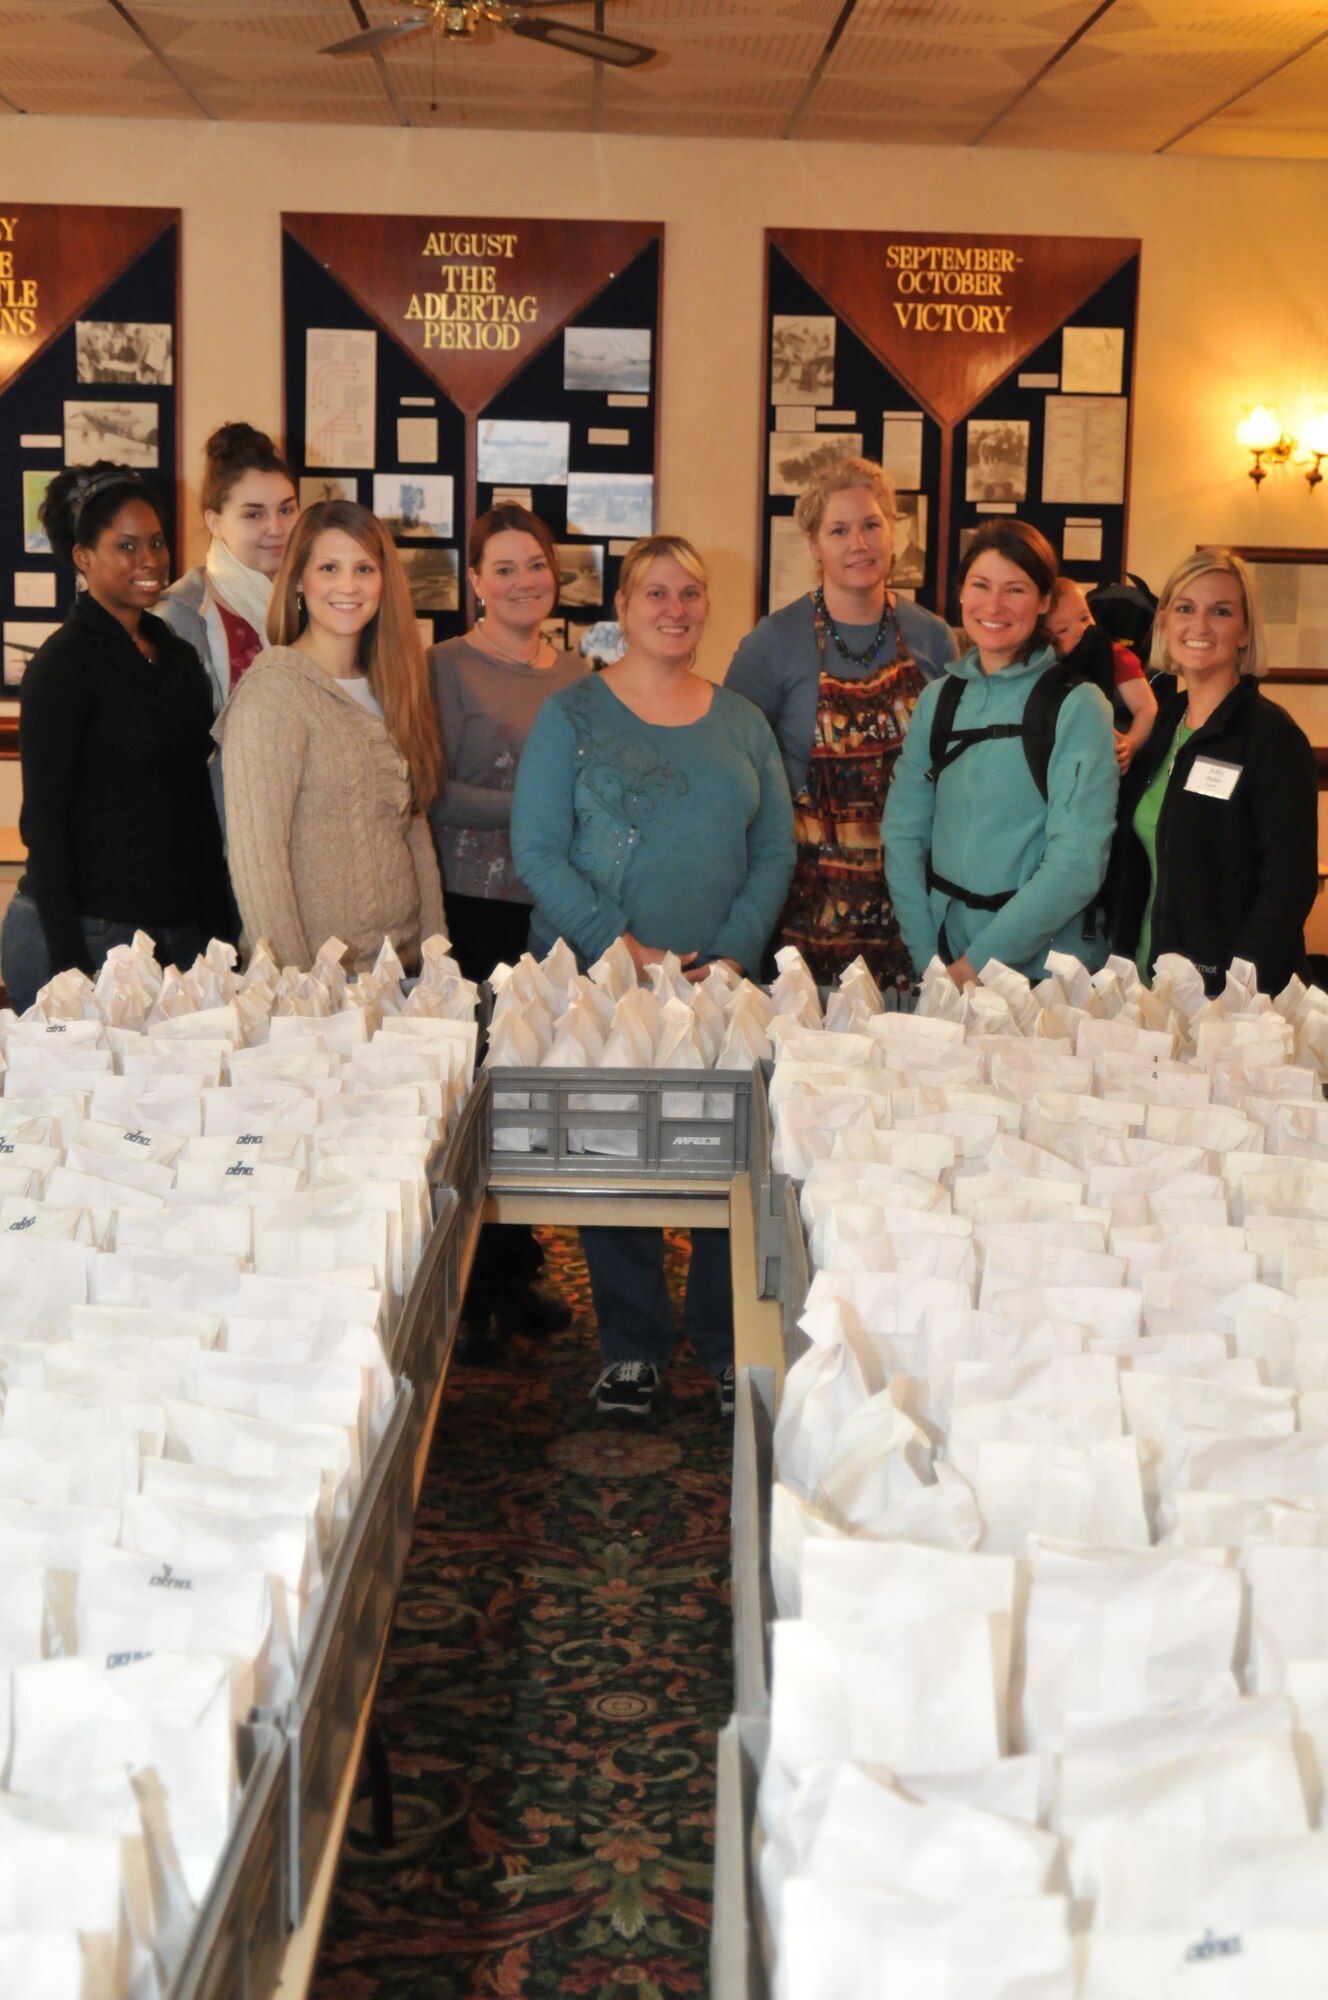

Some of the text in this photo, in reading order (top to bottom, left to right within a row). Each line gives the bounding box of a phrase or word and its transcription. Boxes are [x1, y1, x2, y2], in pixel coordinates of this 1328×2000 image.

[0, 217, 19, 241] Y
[421, 231, 518, 258] AUGUST
[886, 245, 1024, 272] SEPTEMBER-
[441, 265, 497, 293] THE
[897, 270, 1003, 296] OCTOBER
[403, 292, 539, 323] ADLERTAG
[893, 302, 1013, 333] VICTORY
[422, 321, 521, 351] PERIOD
[1152, 1071, 1159, 1080] 4
